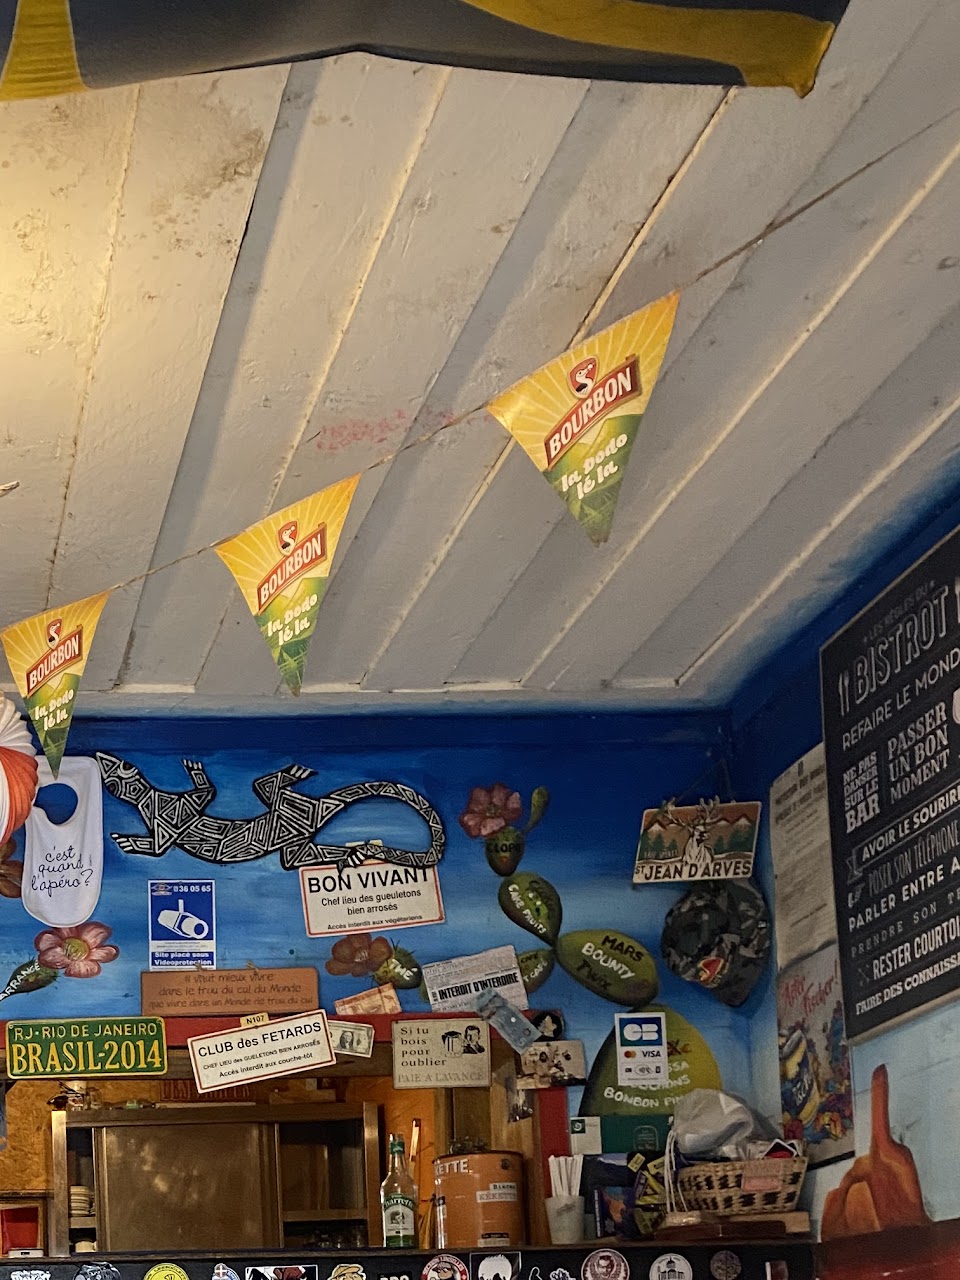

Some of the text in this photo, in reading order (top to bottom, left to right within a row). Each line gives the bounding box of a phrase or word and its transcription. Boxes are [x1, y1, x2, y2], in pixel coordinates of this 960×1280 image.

[549, 367, 632, 459] BOURBON
[560, 470, 582, 492] la
[576, 461, 618, 500] lé la
[260, 533, 321, 605] BOURBON
[267, 619, 283, 637] la
[278, 617, 310, 646] lé la
[854, 585, 949, 705] BISTROT
[29, 634, 79, 690] BOURBON
[34, 705, 48, 720] la
[43, 708, 69, 731] lé la
[842, 698, 893, 751] REFAIRE
[896, 684, 912, 710] LE
[887, 702, 947, 760] PASSER
[889, 724, 949, 781] UN BON
[843, 751, 877, 785] NE PAS
[890, 748, 950, 804] MOMENT
[844, 765, 878, 797] DANSER
[845, 778, 879, 811] SUR LE
[845, 793, 881, 833] BAR
[862, 819, 910, 862] AVOIR LE
[38, 853, 84, 878] quand
[45, 845, 76, 862] c'est
[869, 819, 960, 897] POSER SON TÉLÉPHONE
[308, 868, 430, 893] BON VIVANT
[644, 865, 683, 881] JEAN
[684, 860, 752, 878] D'ARVES
[321, 889, 422, 907] Chef lieu des gueuletons
[347, 903, 398, 916] bien arrosés
[849, 865, 944, 932] PARLER ENTRE
[327, 922, 347, 931] Accès
[348, 920, 371, 929] interdit
[384, 914, 423, 925] végétariens
[851, 902, 937, 958] PRENDRE SON
[581, 942, 636, 980] BOUNTY
[602, 935, 644, 962] MARS
[873, 942, 911, 981] RESTER
[159, 982, 301, 996] dans le trou du cul du Monde
[194, 971, 273, 982] vaut mieux vivre
[148, 995, 313, 1009] que vivre dans un Monde de trou du cul
[439, 983, 473, 1001] INTERDIT
[856, 981, 903, 1016] FAIRE DES
[71, 1022, 157, 1037] DE JANEIRO
[246, 1015, 265, 1025] N107
[400, 1027, 413, 1035] Si
[623, 1023, 659, 1041] CB
[198, 1021, 322, 1058] CLUB des FETARDS
[11, 1039, 163, 1074] BRASIL-2014
[203, 1062, 219, 1070] CHEF
[219, 1058, 233, 1067] LIEU
[278, 1045, 292, 1054] BIEN
[219, 1052, 314, 1078] Accès interdit aux couche-tôt
[401, 1058, 447, 1067] oublier
[402, 1048, 430, 1057] pour
[641, 1050, 661, 1058] VISA
[398, 1073, 421, 1083] PAIE
[604, 1087, 660, 1108] BONBON
